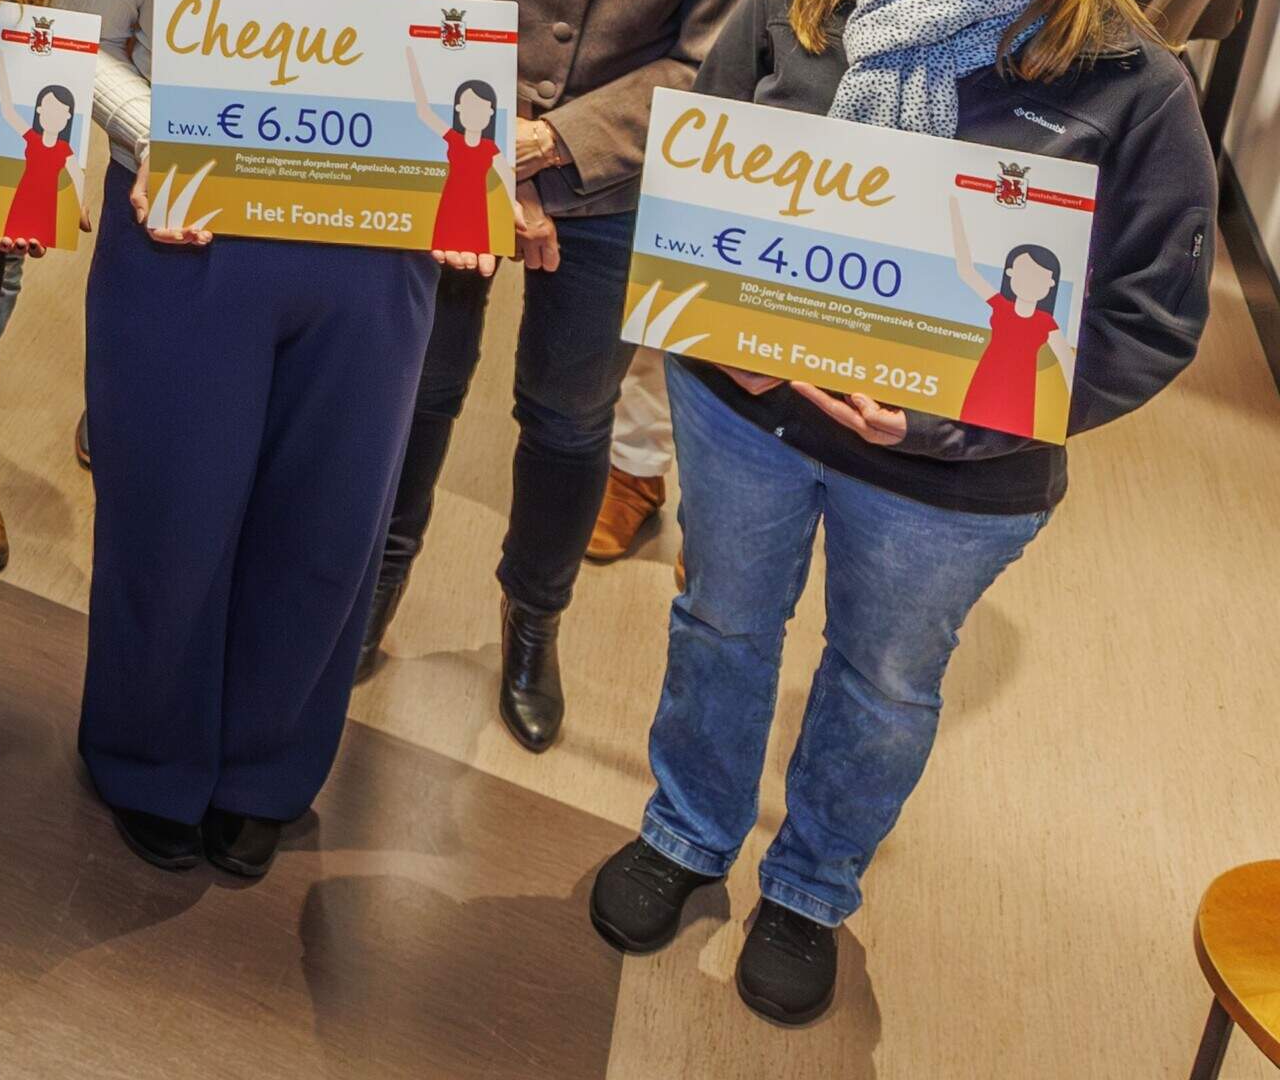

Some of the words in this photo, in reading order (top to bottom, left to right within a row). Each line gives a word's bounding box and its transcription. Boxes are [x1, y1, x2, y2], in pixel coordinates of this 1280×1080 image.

[167, 120, 211, 136] t.w.v.
[216, 103, 244, 139] €
[257, 106, 372, 147] 6.500
[660, 106, 893, 217] Cheque
[246, 201, 284, 222] Het
[291, 204, 354, 227] Fonds
[359, 210, 412, 232] 2025
[654, 233, 704, 257] t.w.v.
[712, 227, 746, 265] €
[758, 237, 901, 297] 4.000
[737, 292, 762, 305] DIO
[762, 297, 818, 319] Gymnastiek
[820, 313, 872, 332] vereniging
[740, 281, 786, 301] 100-jarig
[785, 292, 826, 309] bestaan
[827, 301, 852, 313] DIO
[852, 306, 914, 328] Gymnastiek
[915, 320, 985, 344] Oosterwolde
[737, 331, 783, 360] Het
[790, 344, 866, 380] Fonds
[873, 364, 938, 396] 2025
